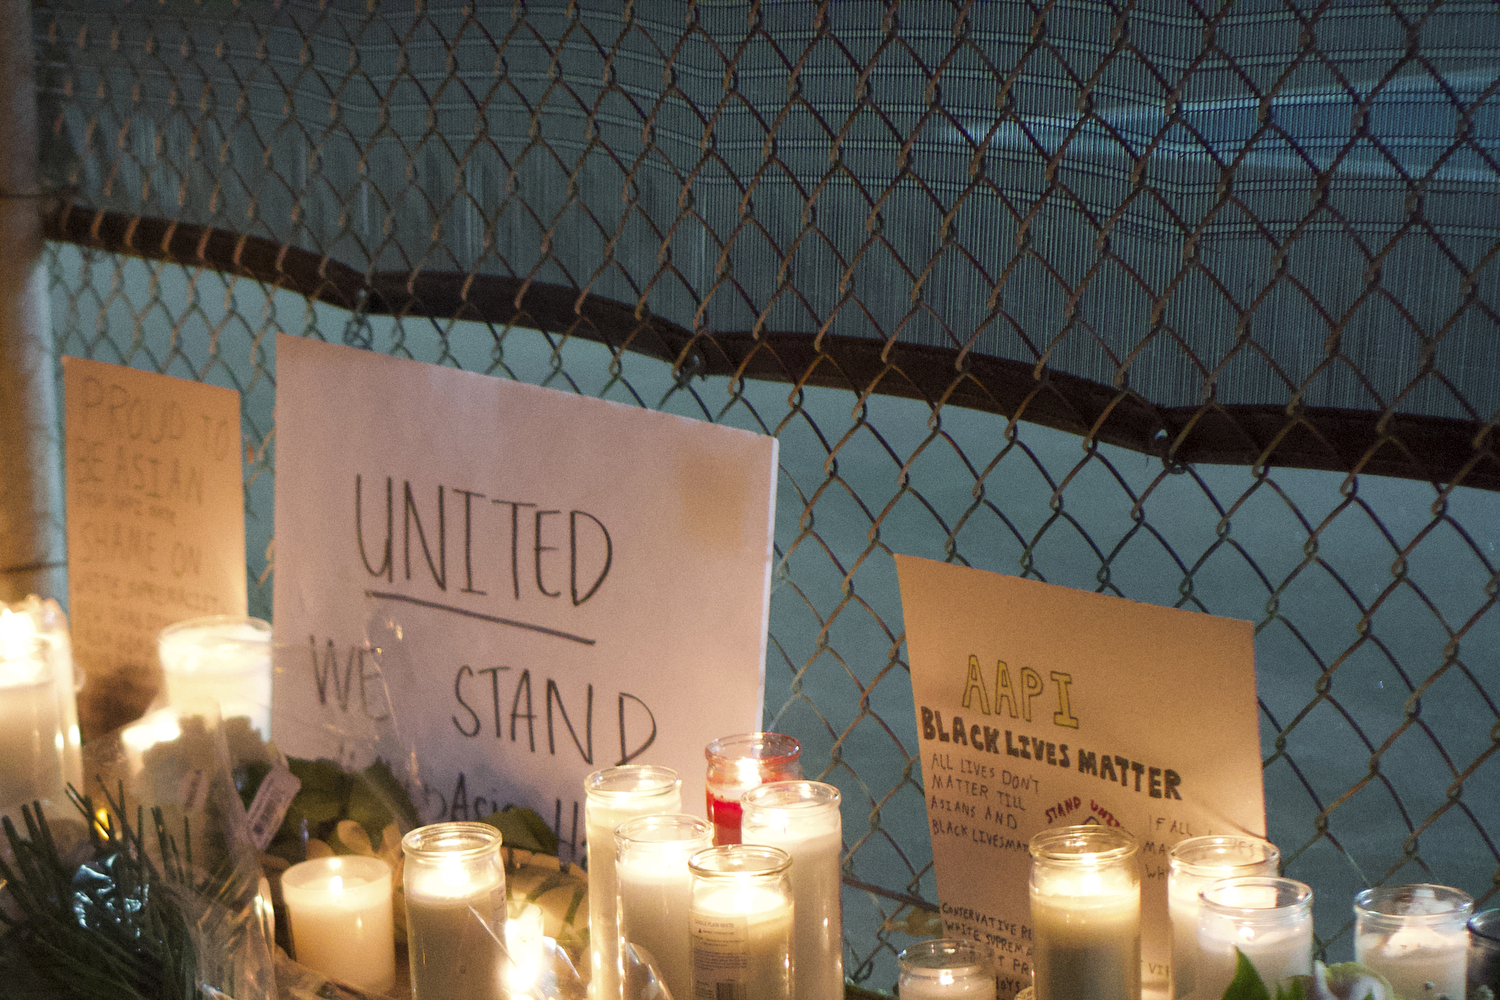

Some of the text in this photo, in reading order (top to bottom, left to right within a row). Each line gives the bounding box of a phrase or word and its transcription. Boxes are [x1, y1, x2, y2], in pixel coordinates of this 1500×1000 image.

[82, 374, 231, 462] PROUD TO
[75, 436, 204, 507] BE ASIAN
[170, 541, 203, 579] ON
[356, 473, 613, 606] UNITED
[309, 634, 391, 723] WE
[961, 653, 1080, 730] AAPI
[451, 664, 658, 767] STAND
[920, 705, 1183, 801] BLACK LIVES MATTER
[931, 752, 1040, 795] ALL LIVES DON'T
[930, 795, 1018, 830] ASIANS AND
[931, 773, 1026, 812] MATTER TILL
[1045, 796, 1082, 824] STAND
[931, 818, 969, 837] BLACK
[1169, 820, 1193, 838] ALL
[944, 920, 982, 943] WHITE
[985, 933, 1033, 957] SUPREMA
